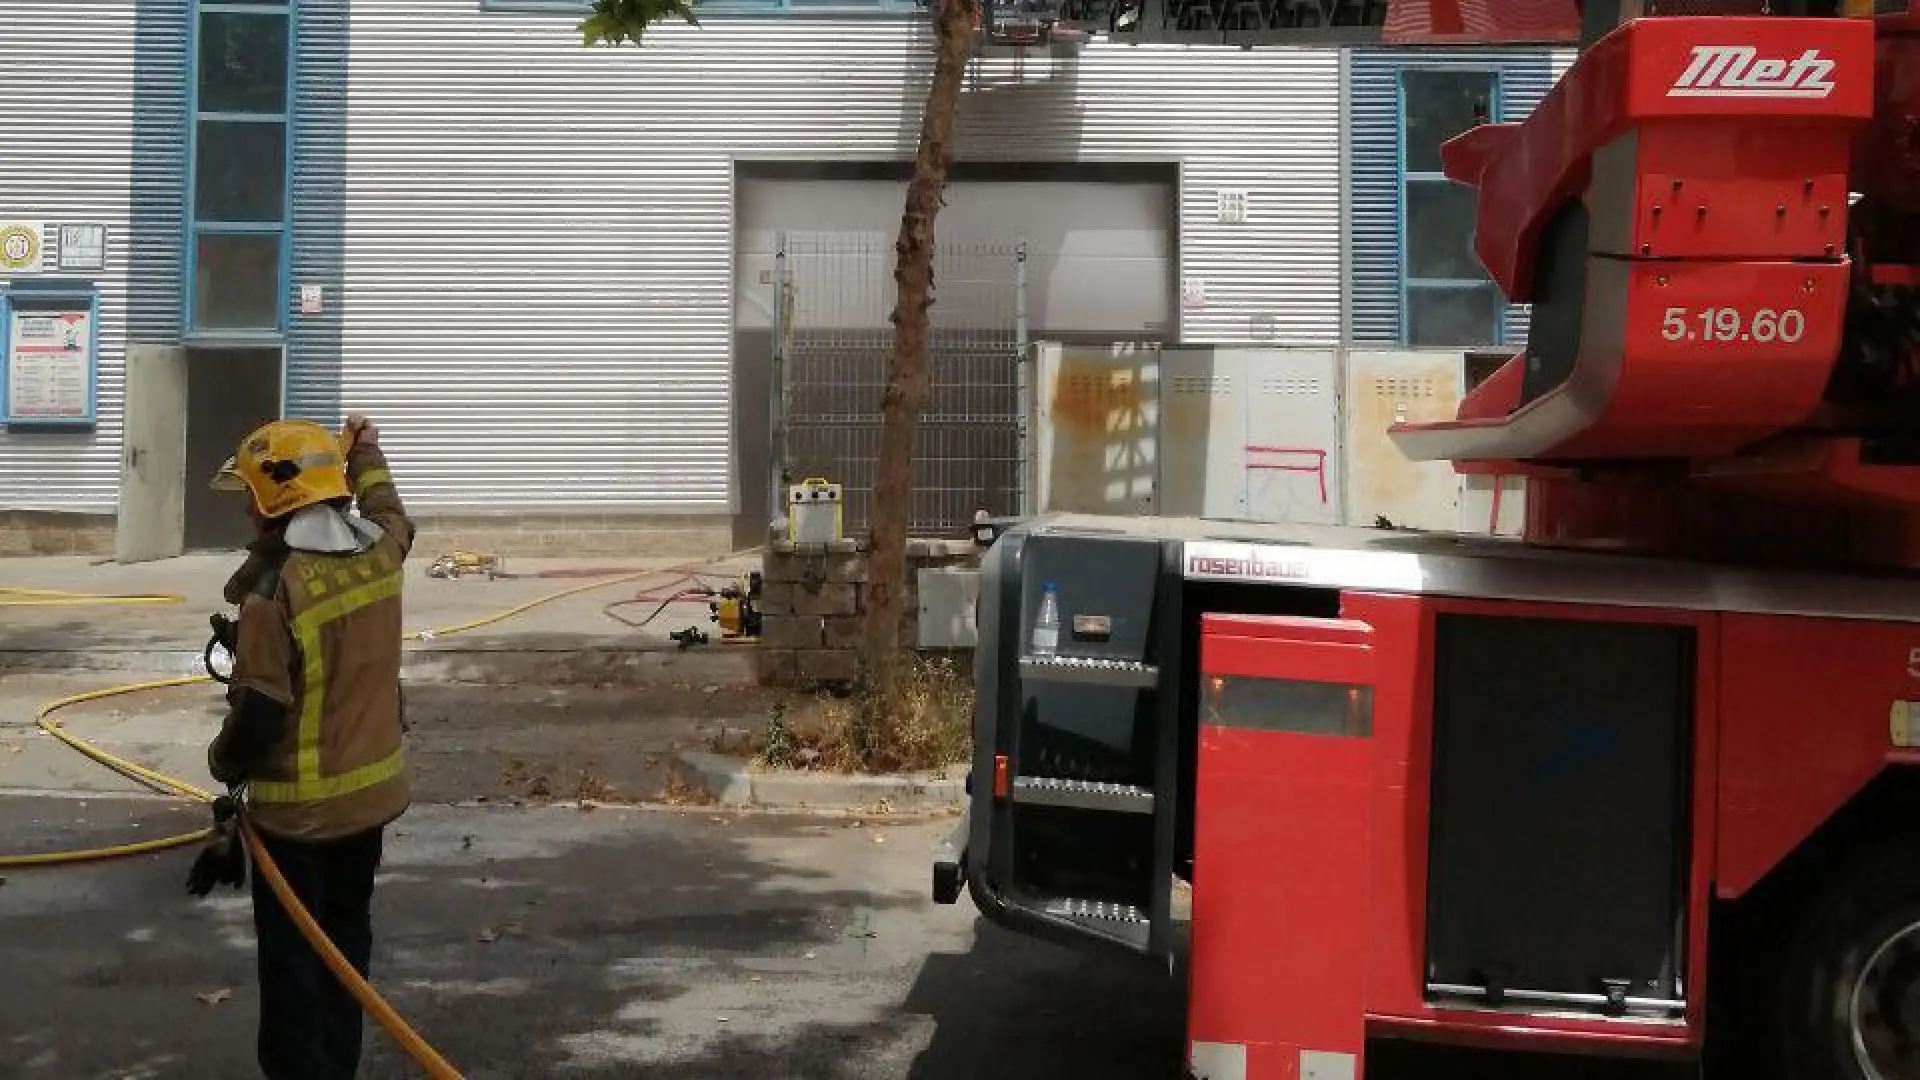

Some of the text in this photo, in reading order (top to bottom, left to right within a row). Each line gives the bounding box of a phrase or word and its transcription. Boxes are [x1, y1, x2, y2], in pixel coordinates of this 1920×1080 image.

[1667, 45, 1836, 98] Metz
[1661, 307, 1805, 343] 5.19.60
[1189, 550, 1311, 578] rosenbaue
